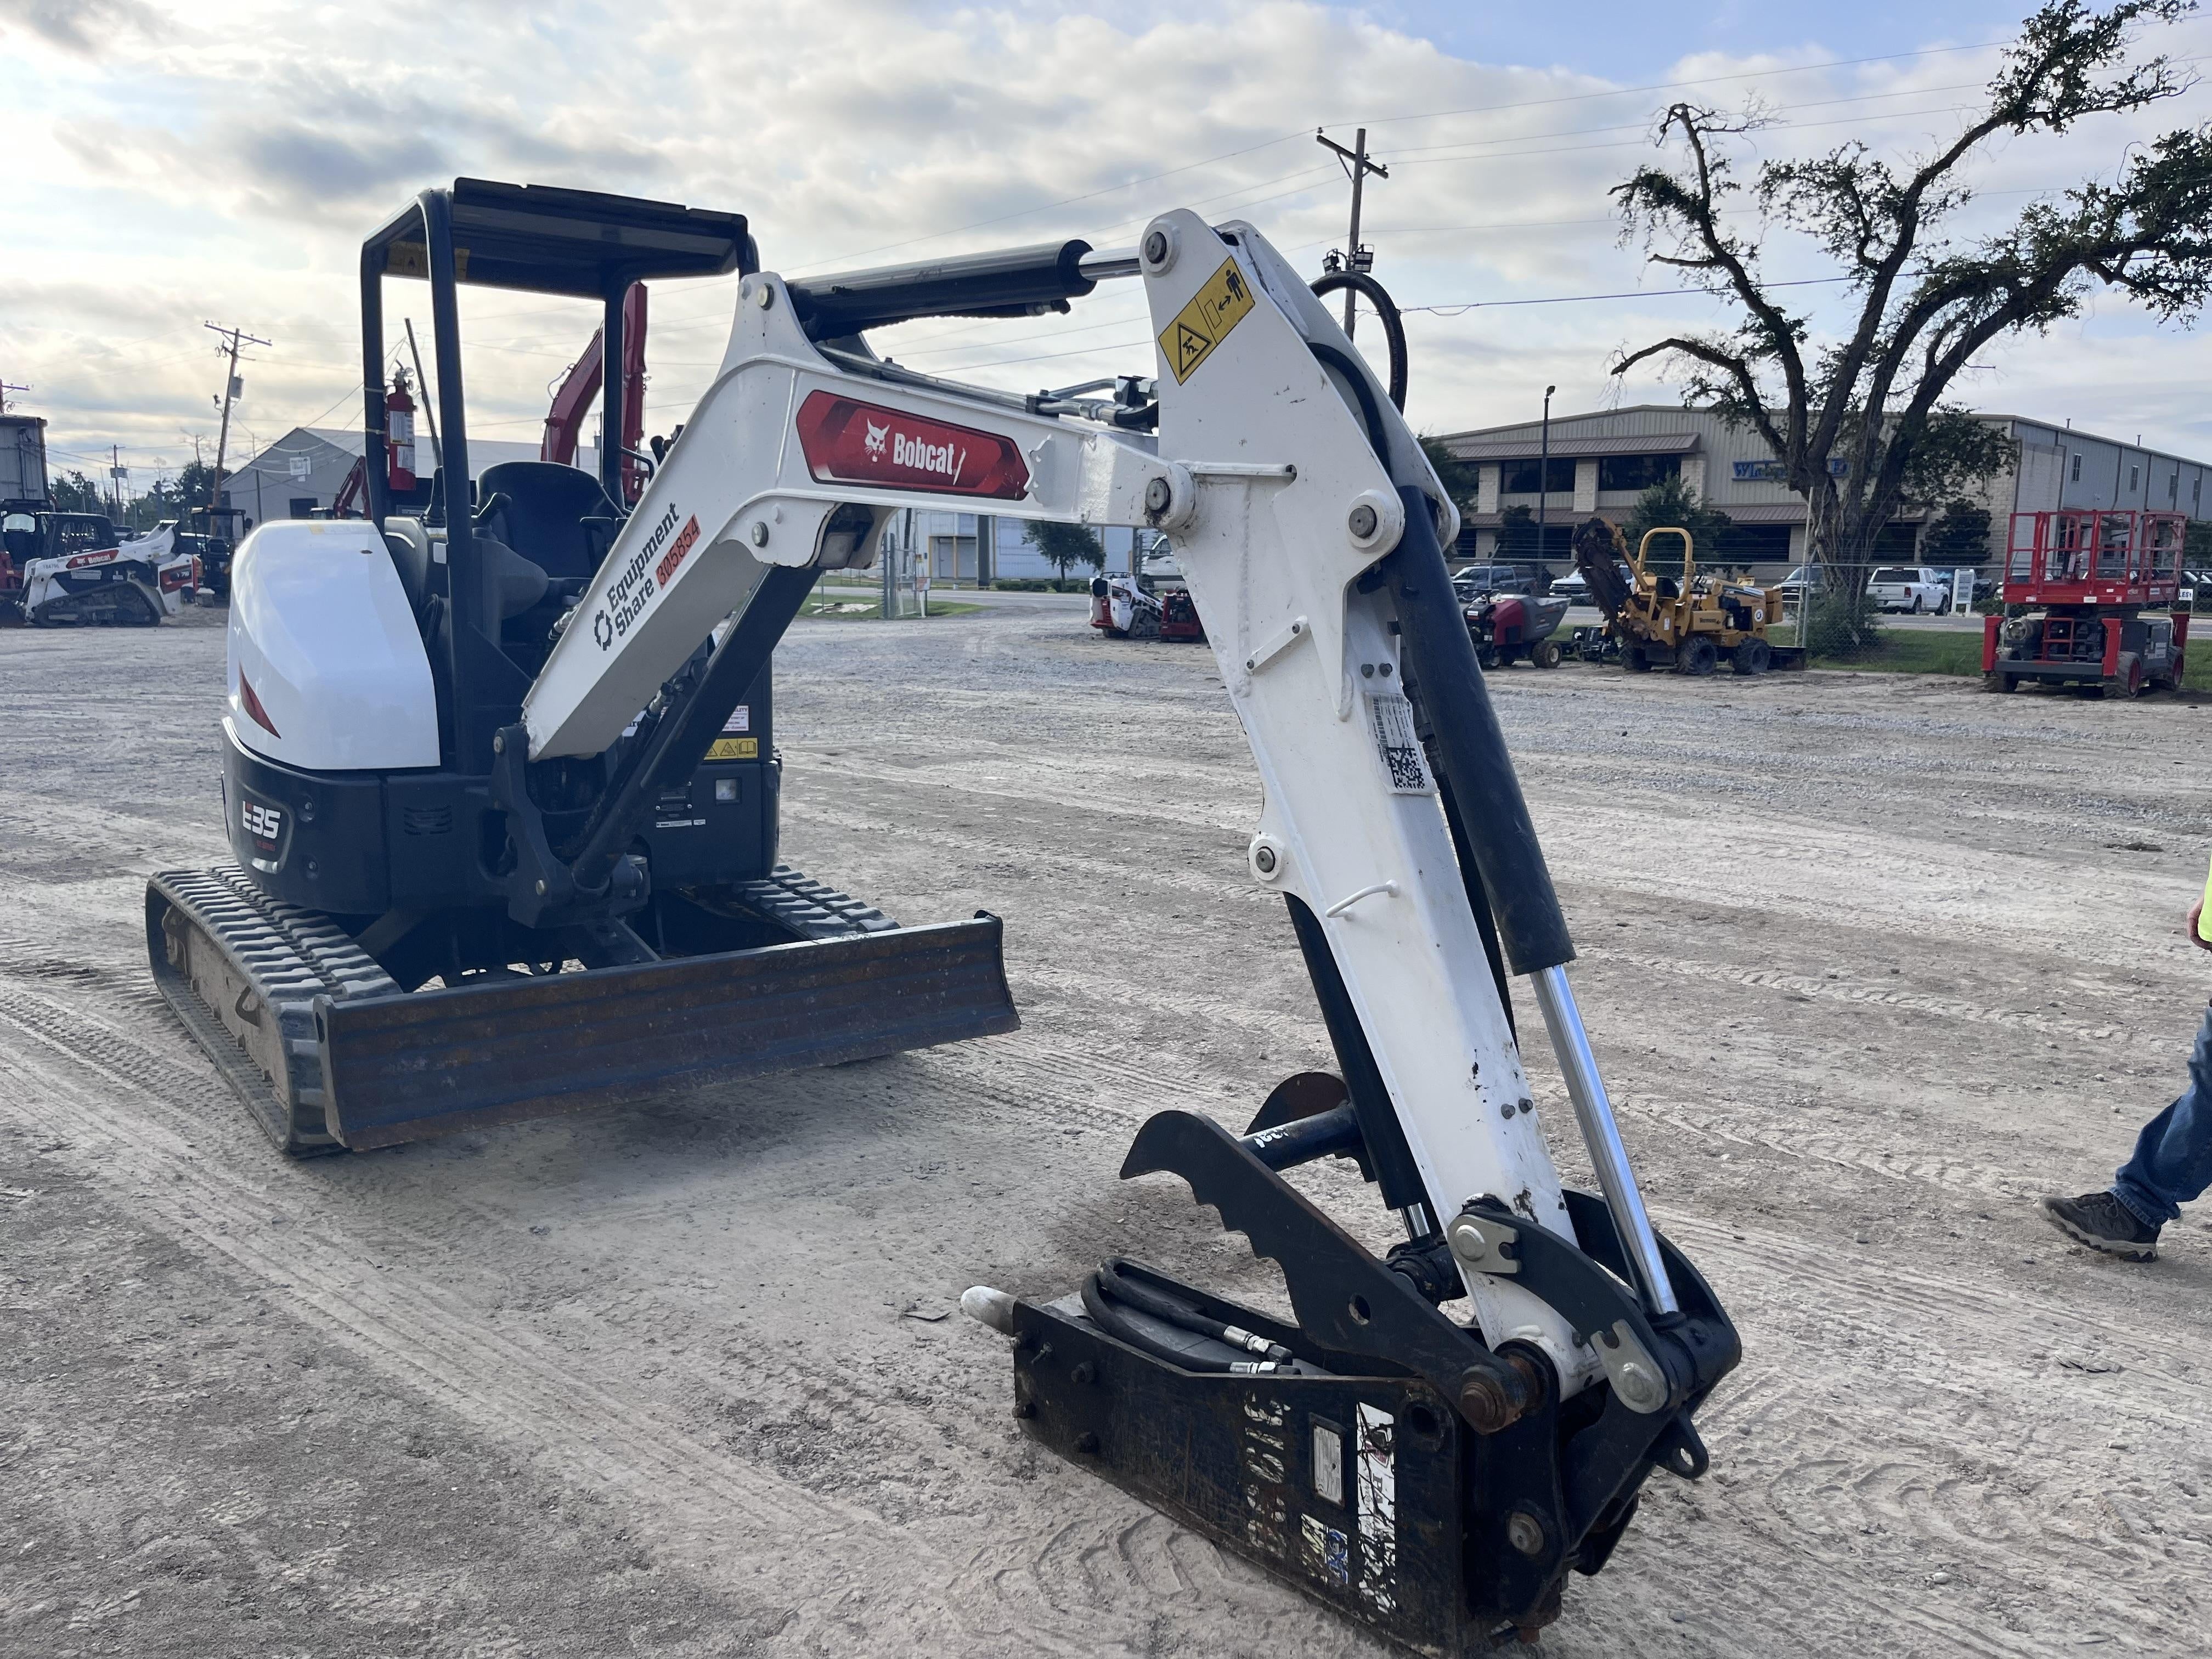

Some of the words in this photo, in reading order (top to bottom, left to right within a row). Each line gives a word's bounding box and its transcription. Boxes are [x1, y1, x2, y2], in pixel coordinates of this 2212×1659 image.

[893, 433, 954, 476] Bobcat
[88, 554, 111, 564] Bobcat
[606, 502, 680, 613] Equipment
[614, 578, 654, 637] Share
[656, 517, 701, 586] 305854
[242, 800, 281, 839] E35
